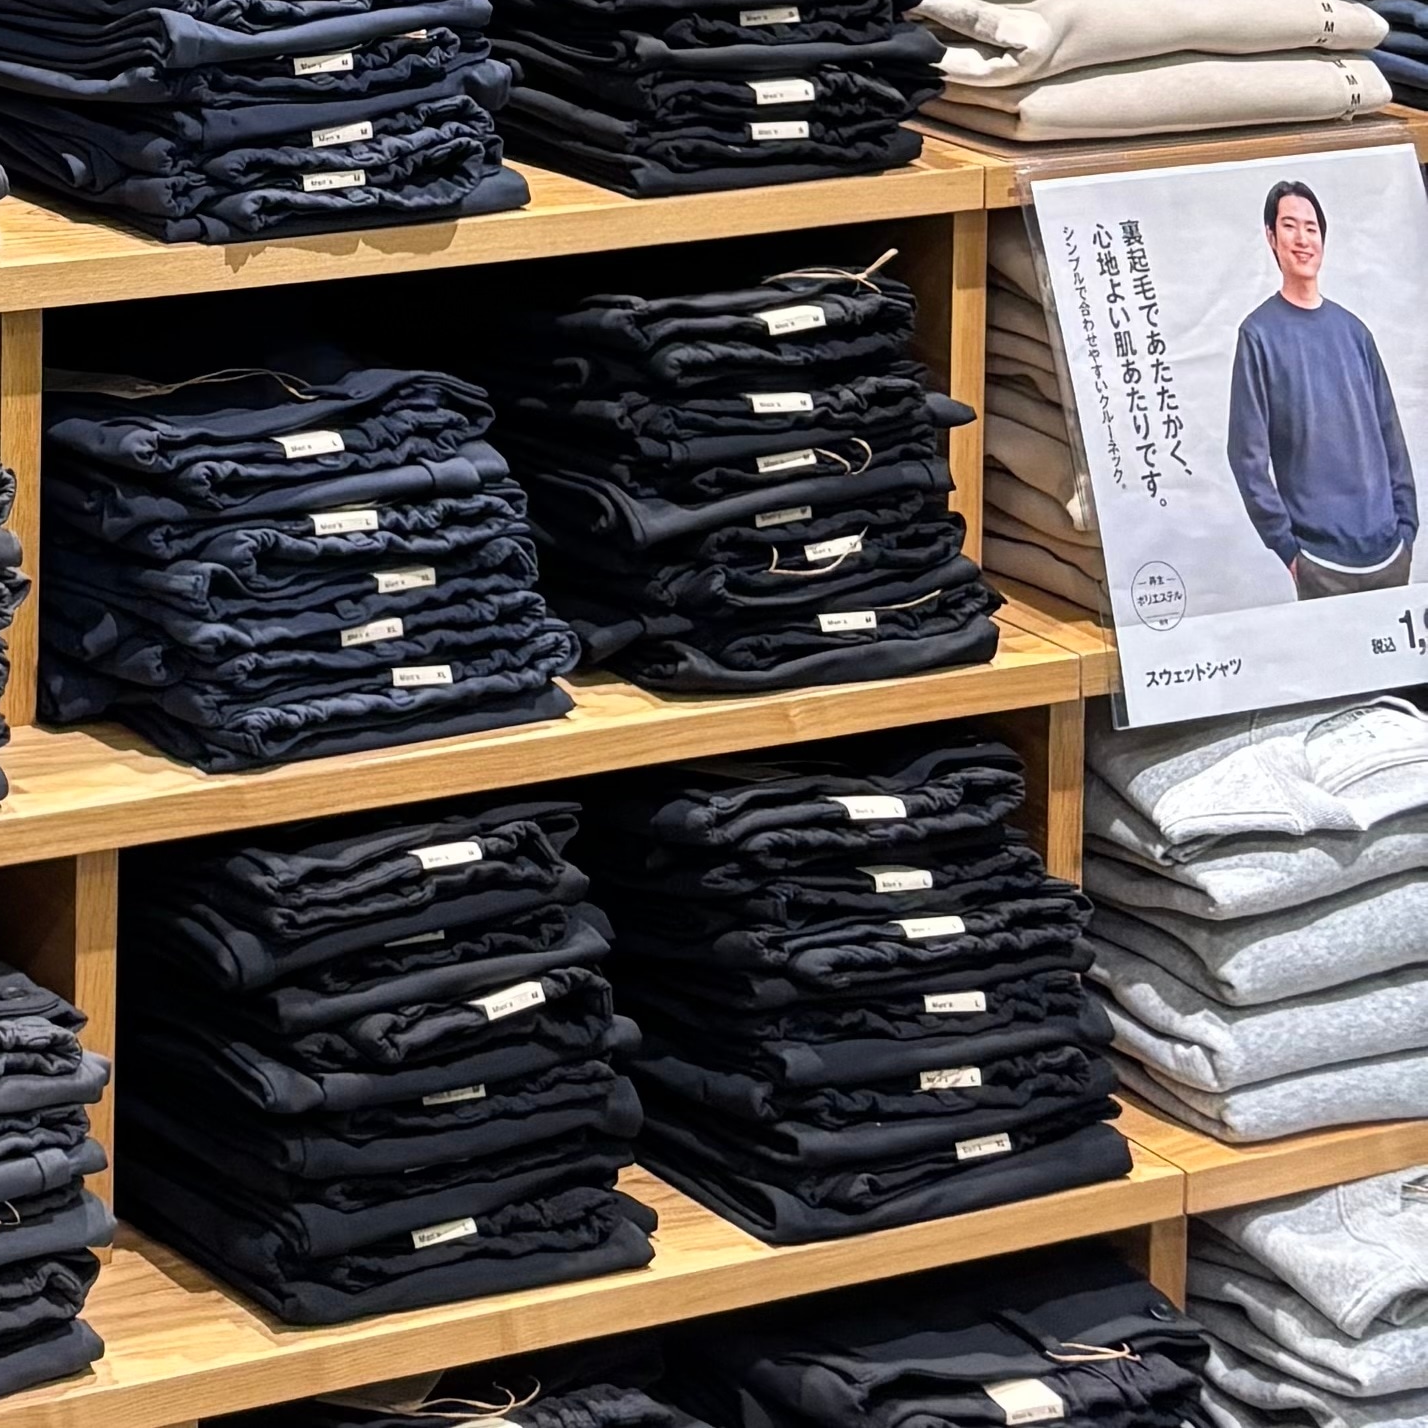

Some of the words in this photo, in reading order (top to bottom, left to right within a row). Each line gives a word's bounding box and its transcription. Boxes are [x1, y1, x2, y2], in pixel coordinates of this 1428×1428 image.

[1323, 20, 1335, 33] M
[1092, 223, 1167, 507] 心地よい肌あたりです。
[1118, 219, 1193, 476] 裏起毛であたたかく、
[1146, 658, 1242, 687] スウェットシャツ
